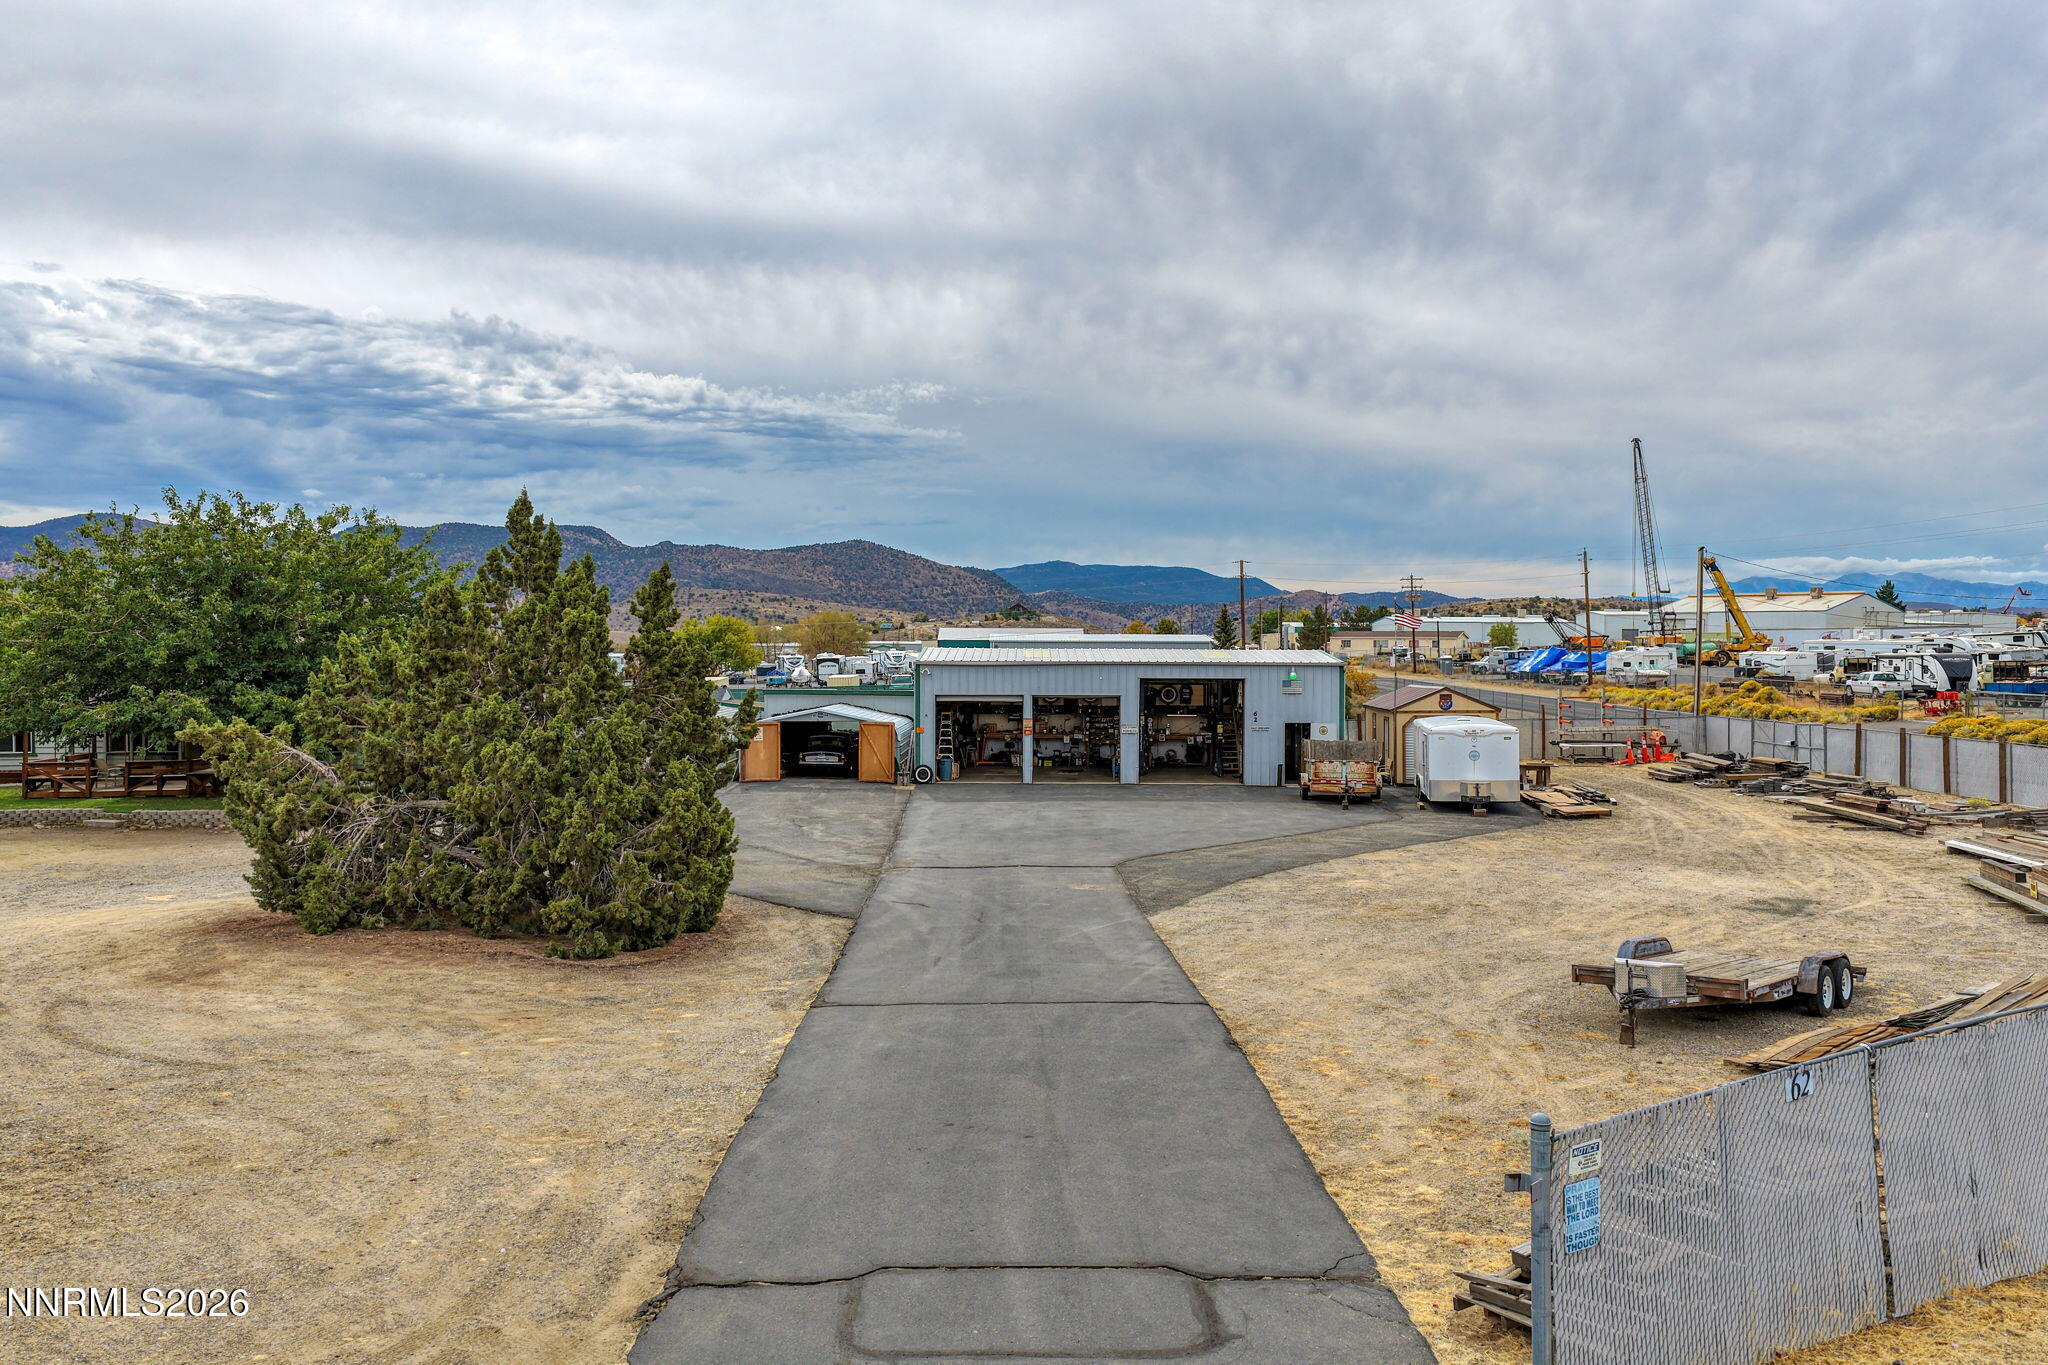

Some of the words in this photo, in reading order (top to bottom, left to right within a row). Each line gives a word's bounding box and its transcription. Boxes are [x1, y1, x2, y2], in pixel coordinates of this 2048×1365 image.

[1791, 1070, 1810, 1100] 62
[1572, 1142, 1599, 1157] NOTICE
[1566, 1178, 1600, 1196] PRAYER
[1566, 1196, 1572, 1206] IS
[1572, 1192, 1583, 1203] THE
[1584, 1188, 1599, 1200] BEST
[1579, 1201, 1585, 1211] TO
[1586, 1197, 1598, 1208] MEET
[1567, 1212, 1580, 1225] THE
[1582, 1206, 1599, 1219] LORD
[1566, 1234, 1573, 1244] IS
[1575, 1225, 1599, 1241] FASTER
[1566, 1234, 1599, 1252] THOUGH
